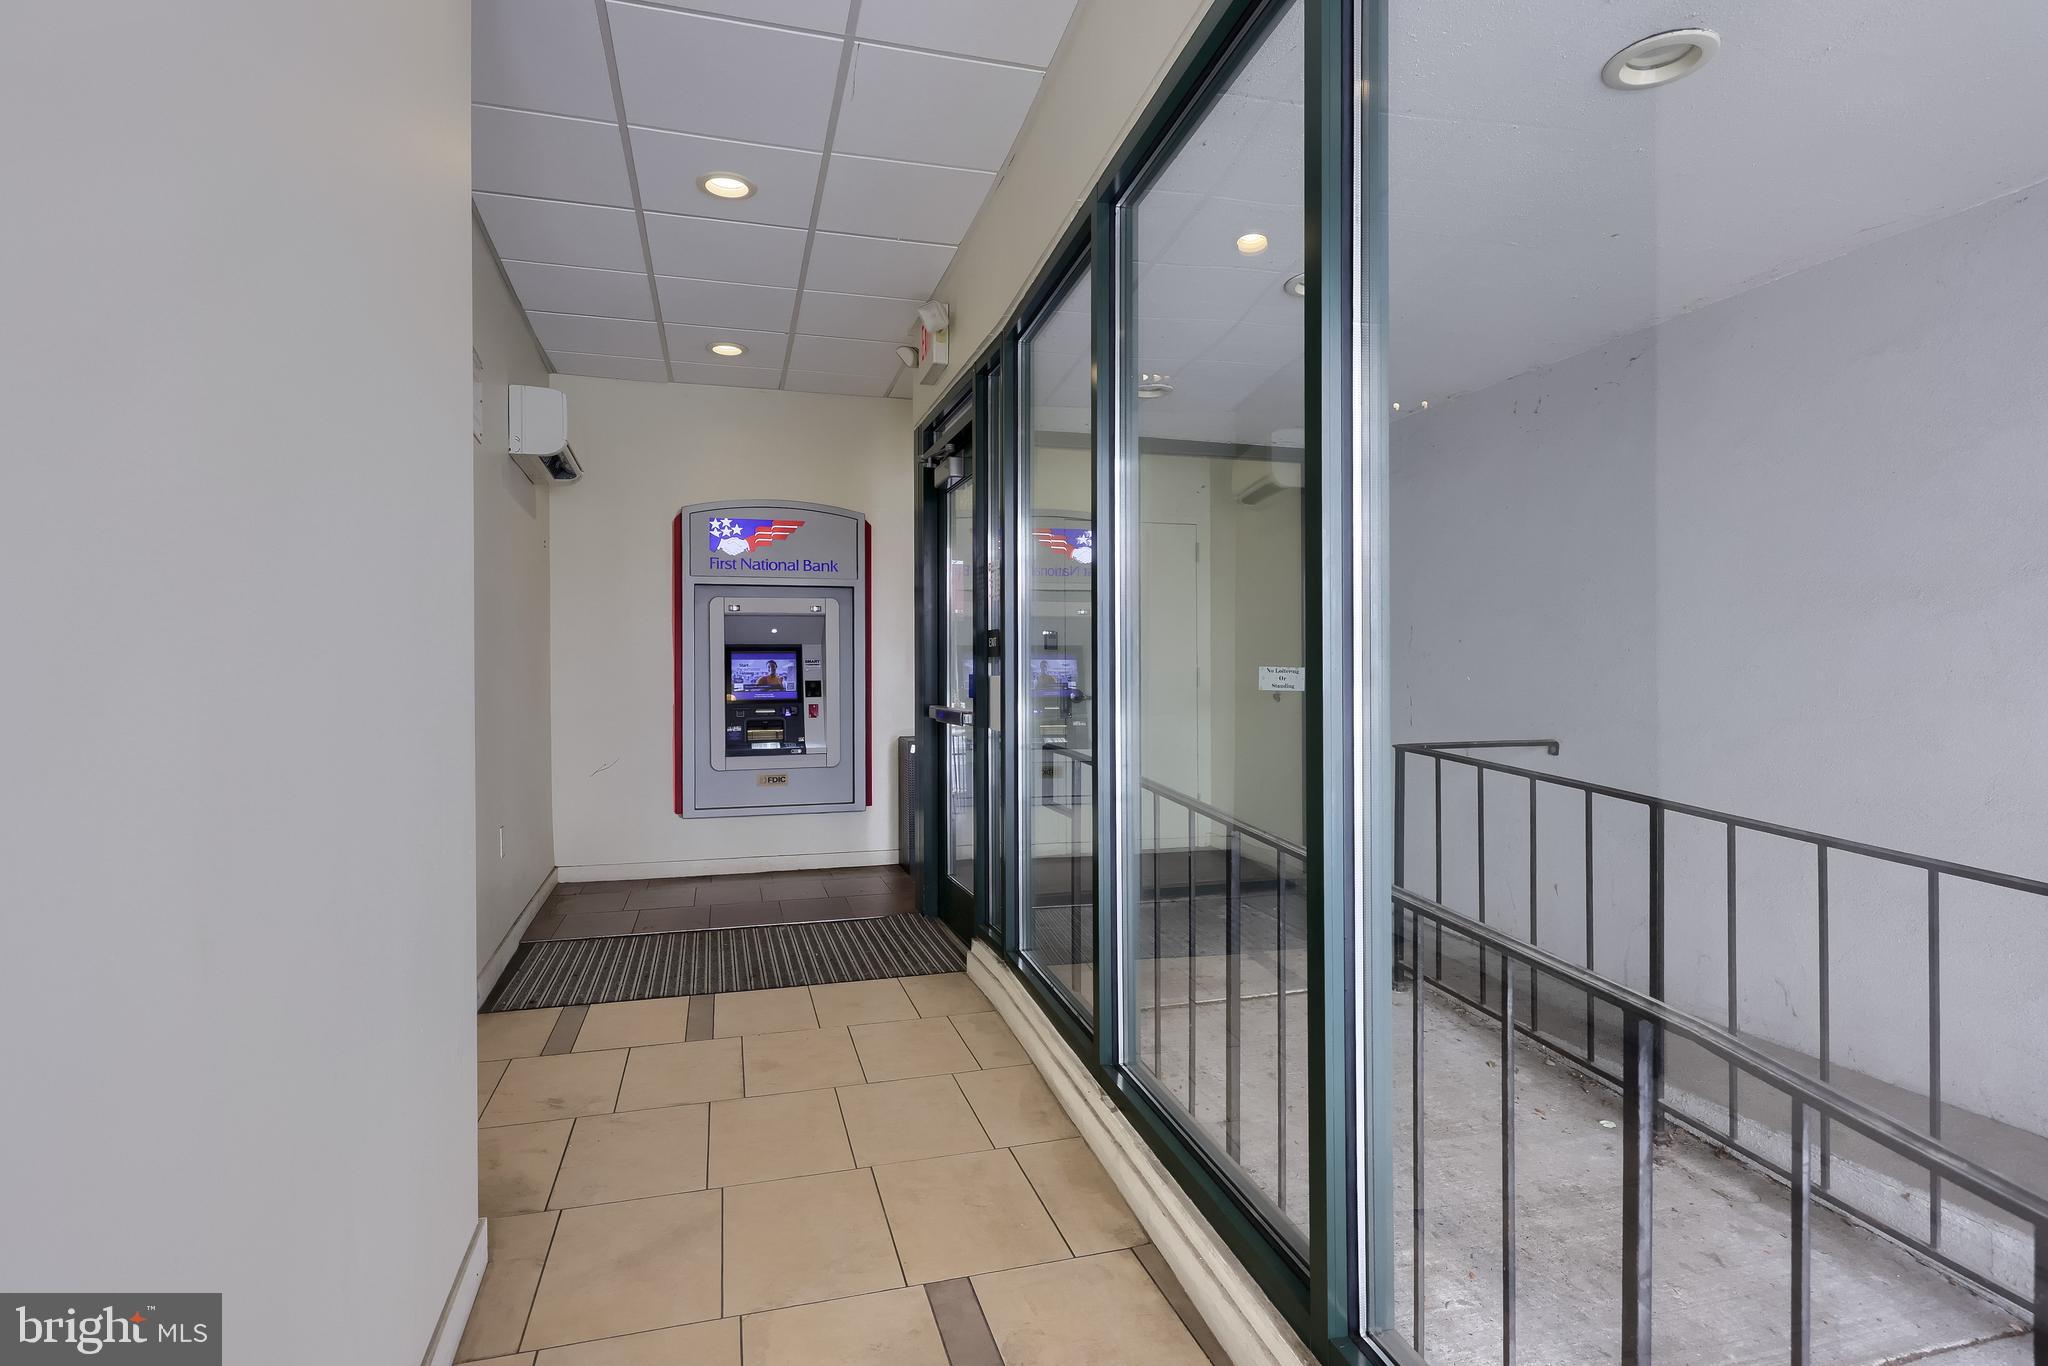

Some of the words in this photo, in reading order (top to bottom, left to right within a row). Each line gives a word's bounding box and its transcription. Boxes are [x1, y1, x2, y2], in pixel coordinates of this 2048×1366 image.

[709, 557, 737, 570] First
[740, 557, 799, 572] National
[803, 559, 839, 573] Bank
[988, 637, 997, 648] EXIT
